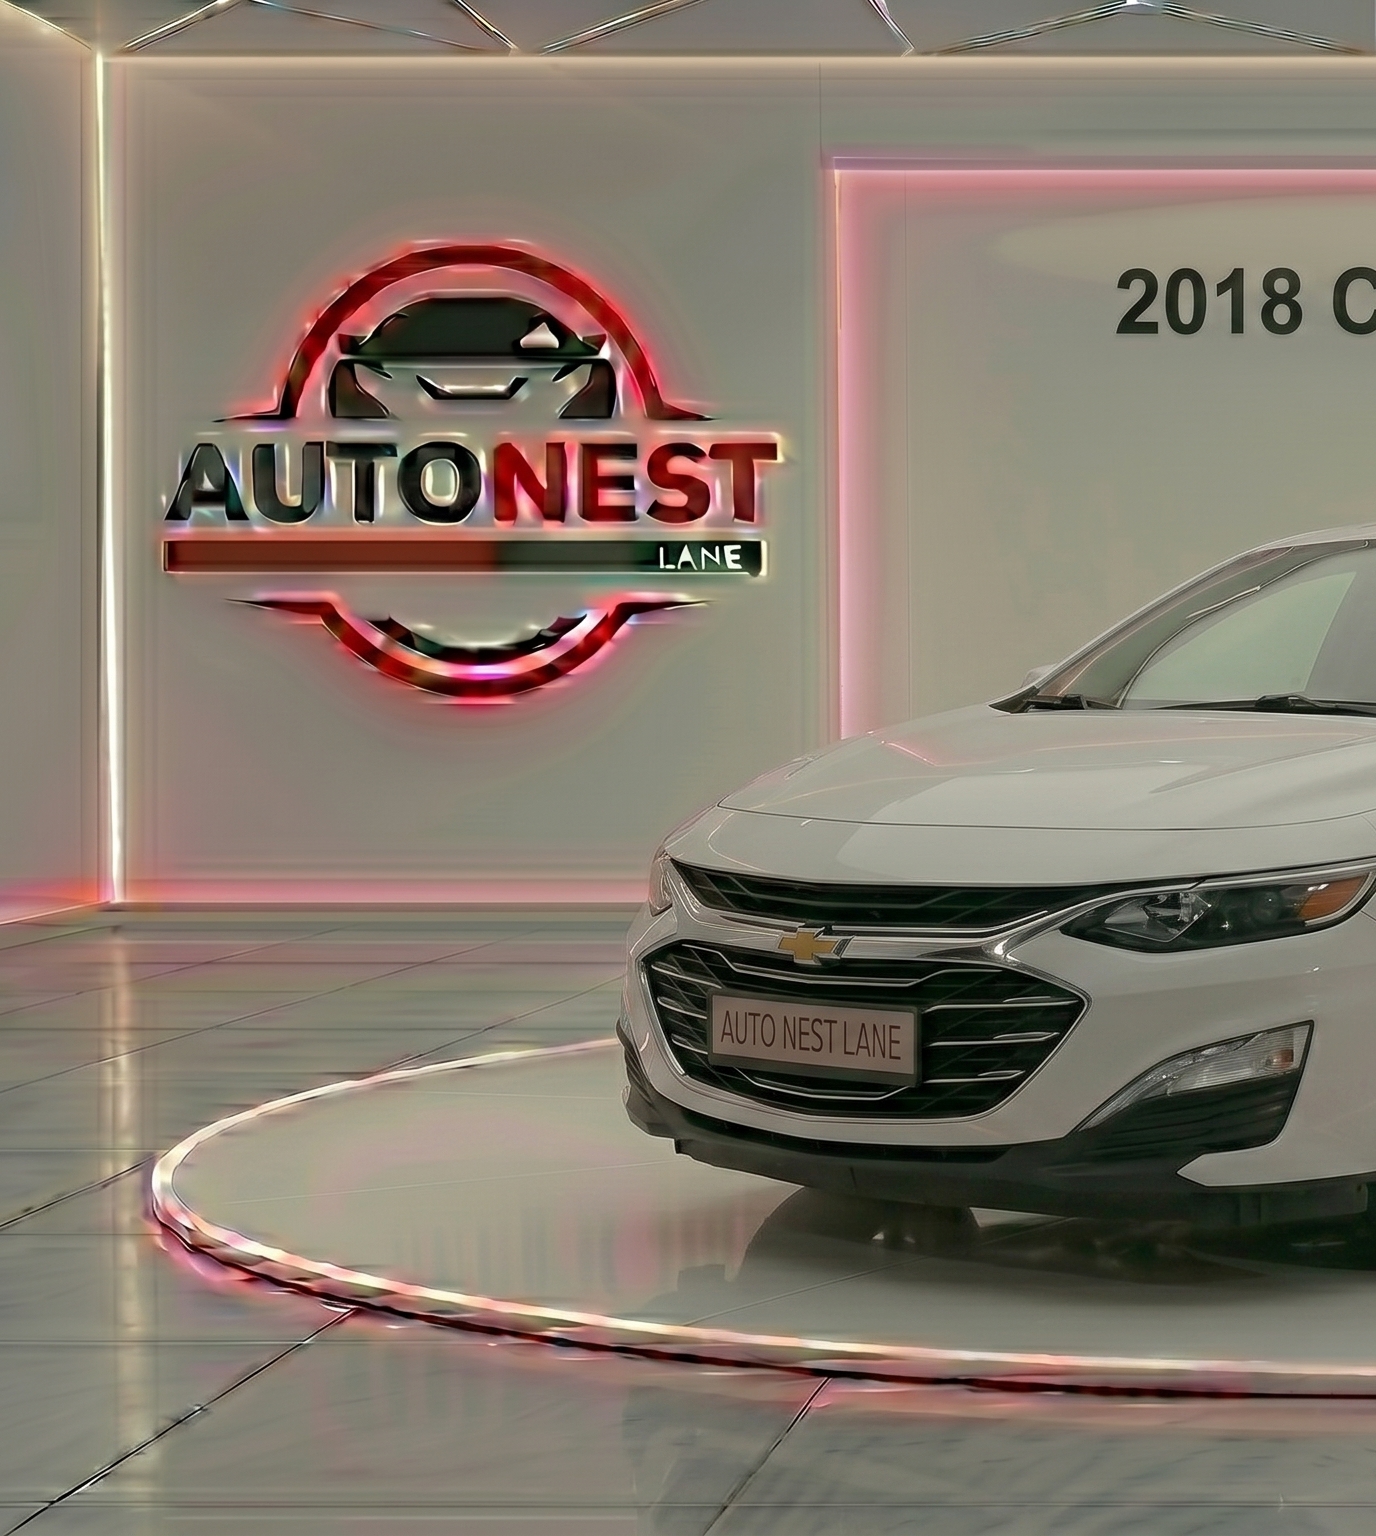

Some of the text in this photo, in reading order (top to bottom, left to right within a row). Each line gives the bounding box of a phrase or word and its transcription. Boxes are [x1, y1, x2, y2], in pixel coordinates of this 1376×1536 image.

[1115, 266, 1303, 337] 2018
[163, 440, 779, 525] AUTONEST
[659, 544, 742, 571] LANE
[720, 1010, 902, 1060] AUTO NEST LANE
